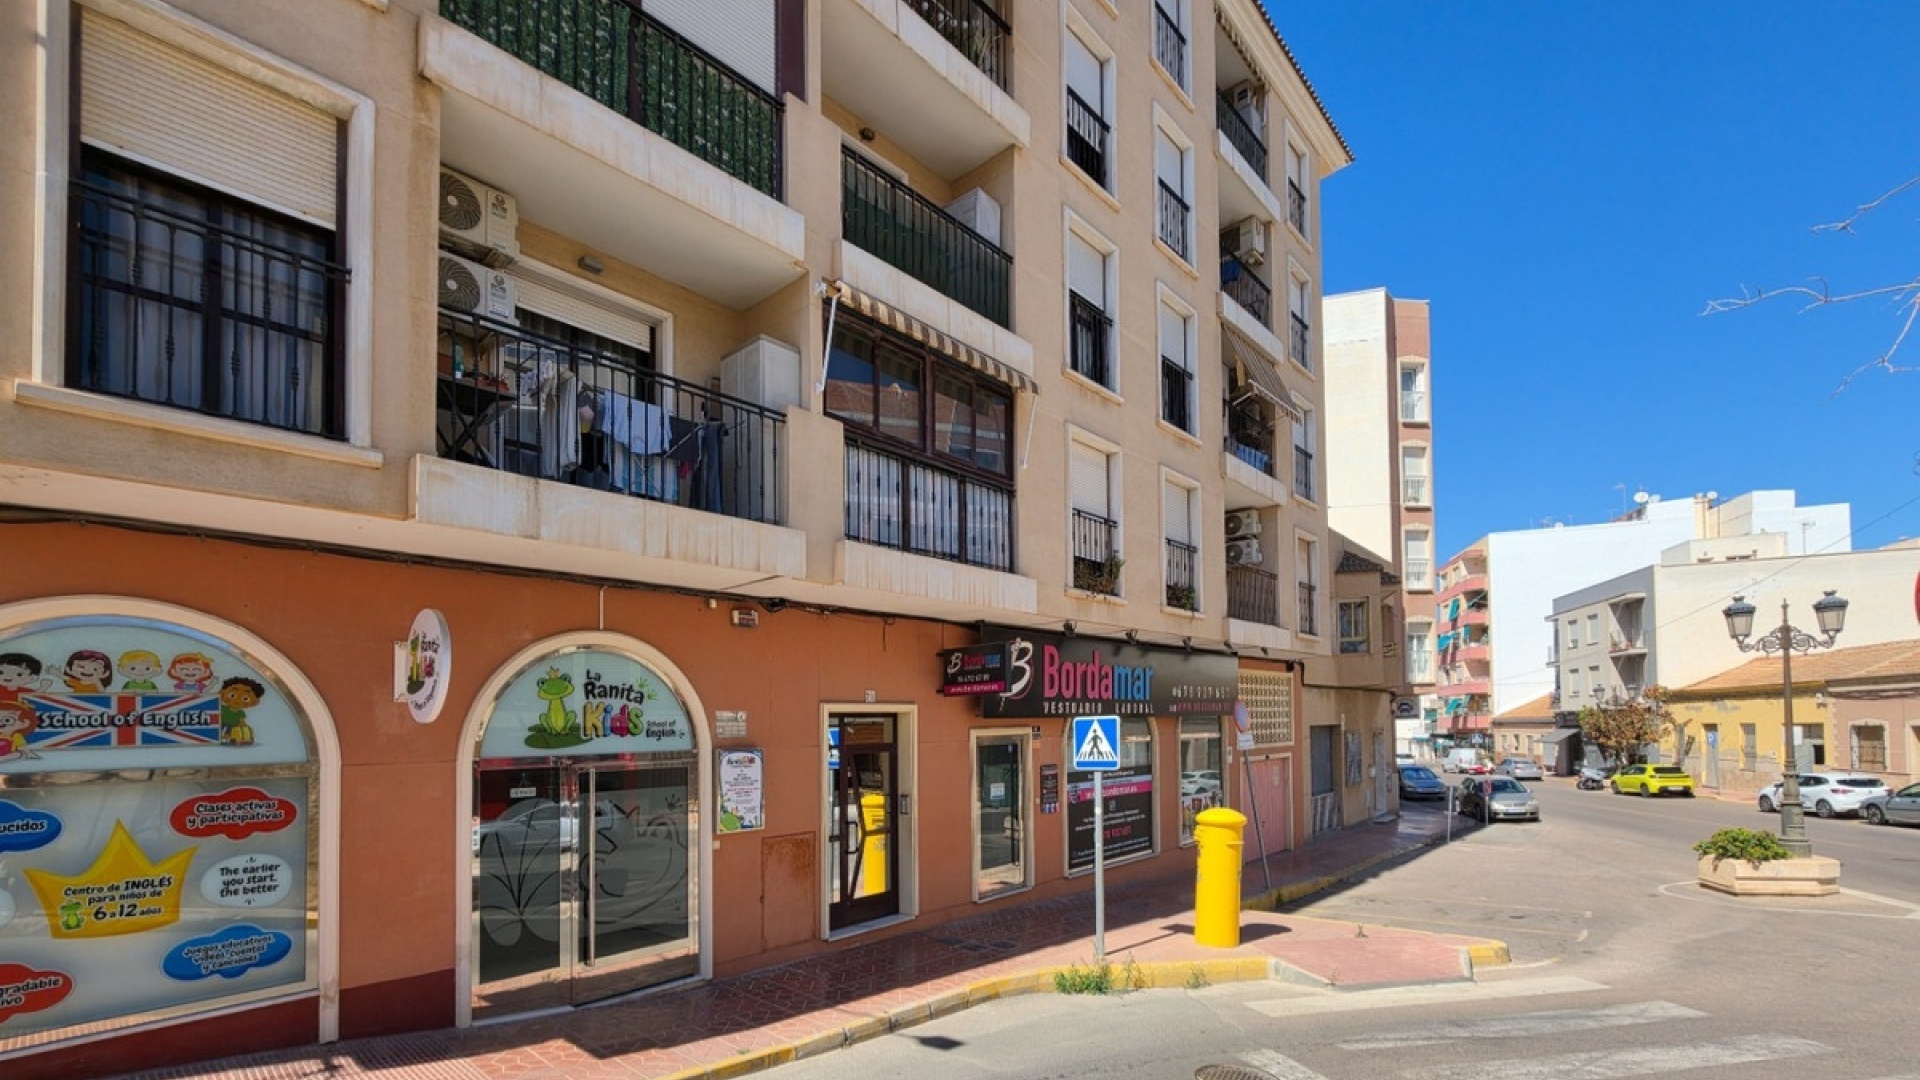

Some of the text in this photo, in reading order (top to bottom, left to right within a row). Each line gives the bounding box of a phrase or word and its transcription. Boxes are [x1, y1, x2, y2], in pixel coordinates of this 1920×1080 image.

[586, 669, 601, 680] La
[1043, 645, 1153, 699] Bordamar
[584, 681, 645, 705] Ranita
[1043, 702, 1102, 714] VESTUARIO
[40, 711, 210, 731] School of English
[583, 701, 644, 737] Kids
[646, 729, 676, 741] English
[197, 801, 277, 813] Clases activas
[188, 811, 282, 828] y participativas
[219, 864, 280, 876] The earlier
[222, 877, 244, 887] you
[64, 887, 104, 896] Centro
[107, 884, 120, 892] de
[220, 884, 279, 897] the better
[88, 894, 115, 906] para
[150, 889, 162, 897] de
[94, 906, 106, 920] 6
[119, 904, 137, 917] 12
